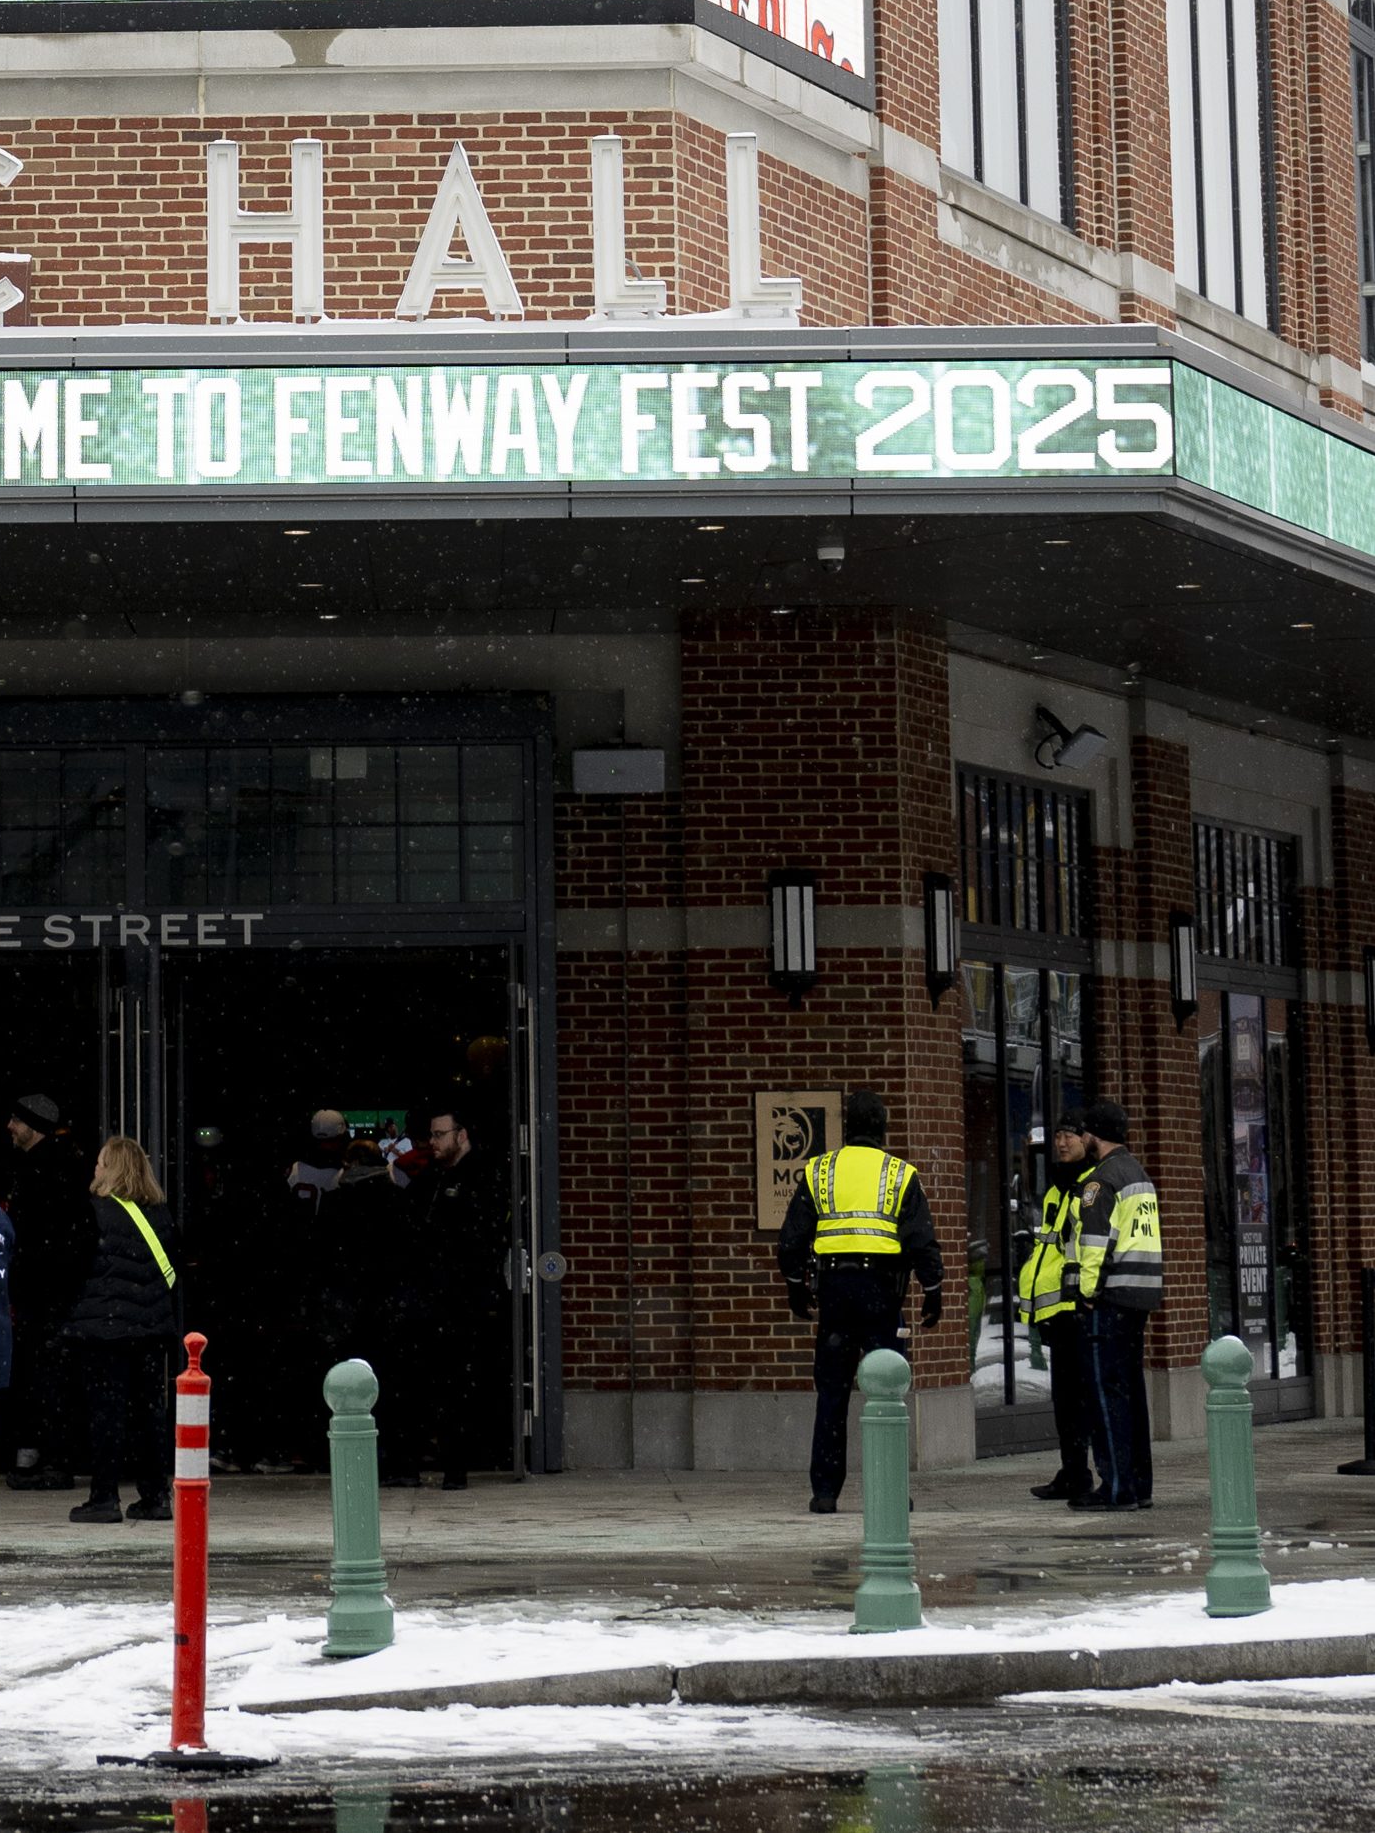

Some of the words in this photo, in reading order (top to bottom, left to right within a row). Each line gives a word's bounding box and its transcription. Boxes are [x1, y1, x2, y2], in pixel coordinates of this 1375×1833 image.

[205, 132, 803, 321] HALL
[143, 377, 242, 478] TO
[275, 373, 590, 478] FENWAY
[624, 370, 823, 475] FEST
[855, 369, 1173, 472] 2025
[43, 913, 264, 947] STREET
[1239, 1245, 1267, 1265] PRIVATE
[1240, 1267, 1268, 1293] EVENT
